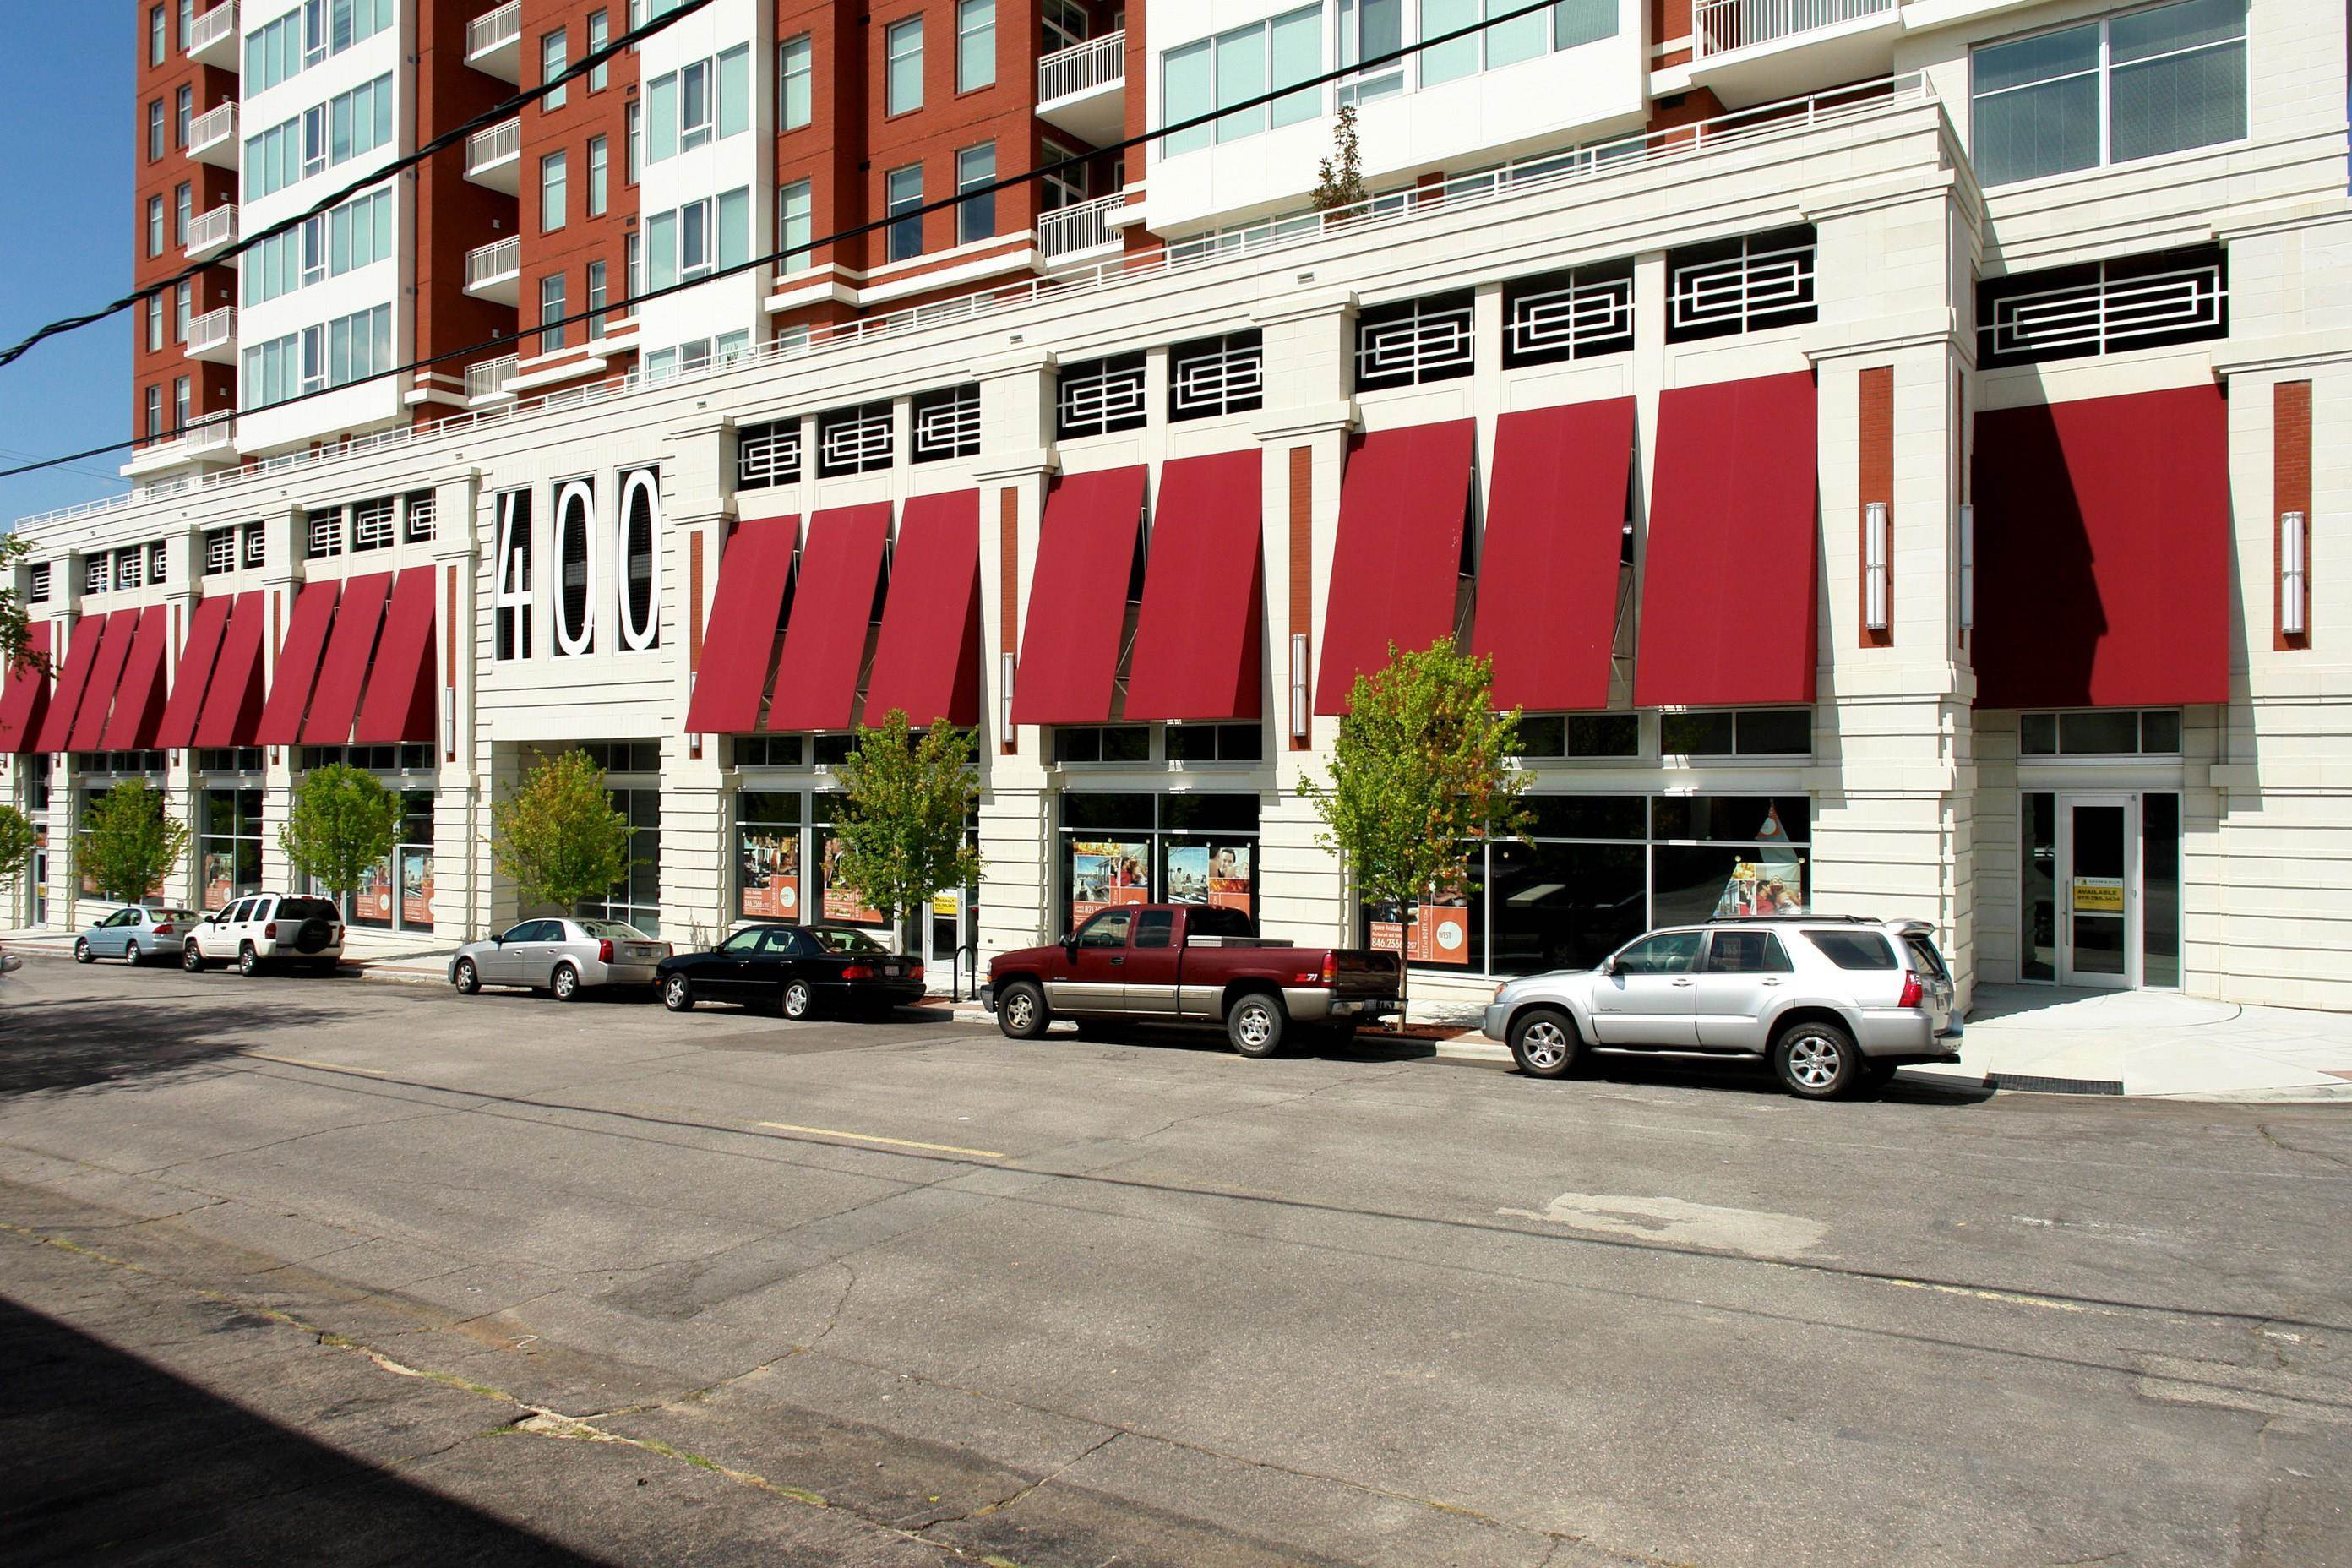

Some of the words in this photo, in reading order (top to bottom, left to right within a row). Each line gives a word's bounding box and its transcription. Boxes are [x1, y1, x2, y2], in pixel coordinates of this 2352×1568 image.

[497, 468, 661, 662] 400
[1439, 931, 1452, 939] WEST
[1295, 973, 1318, 982] Z71
